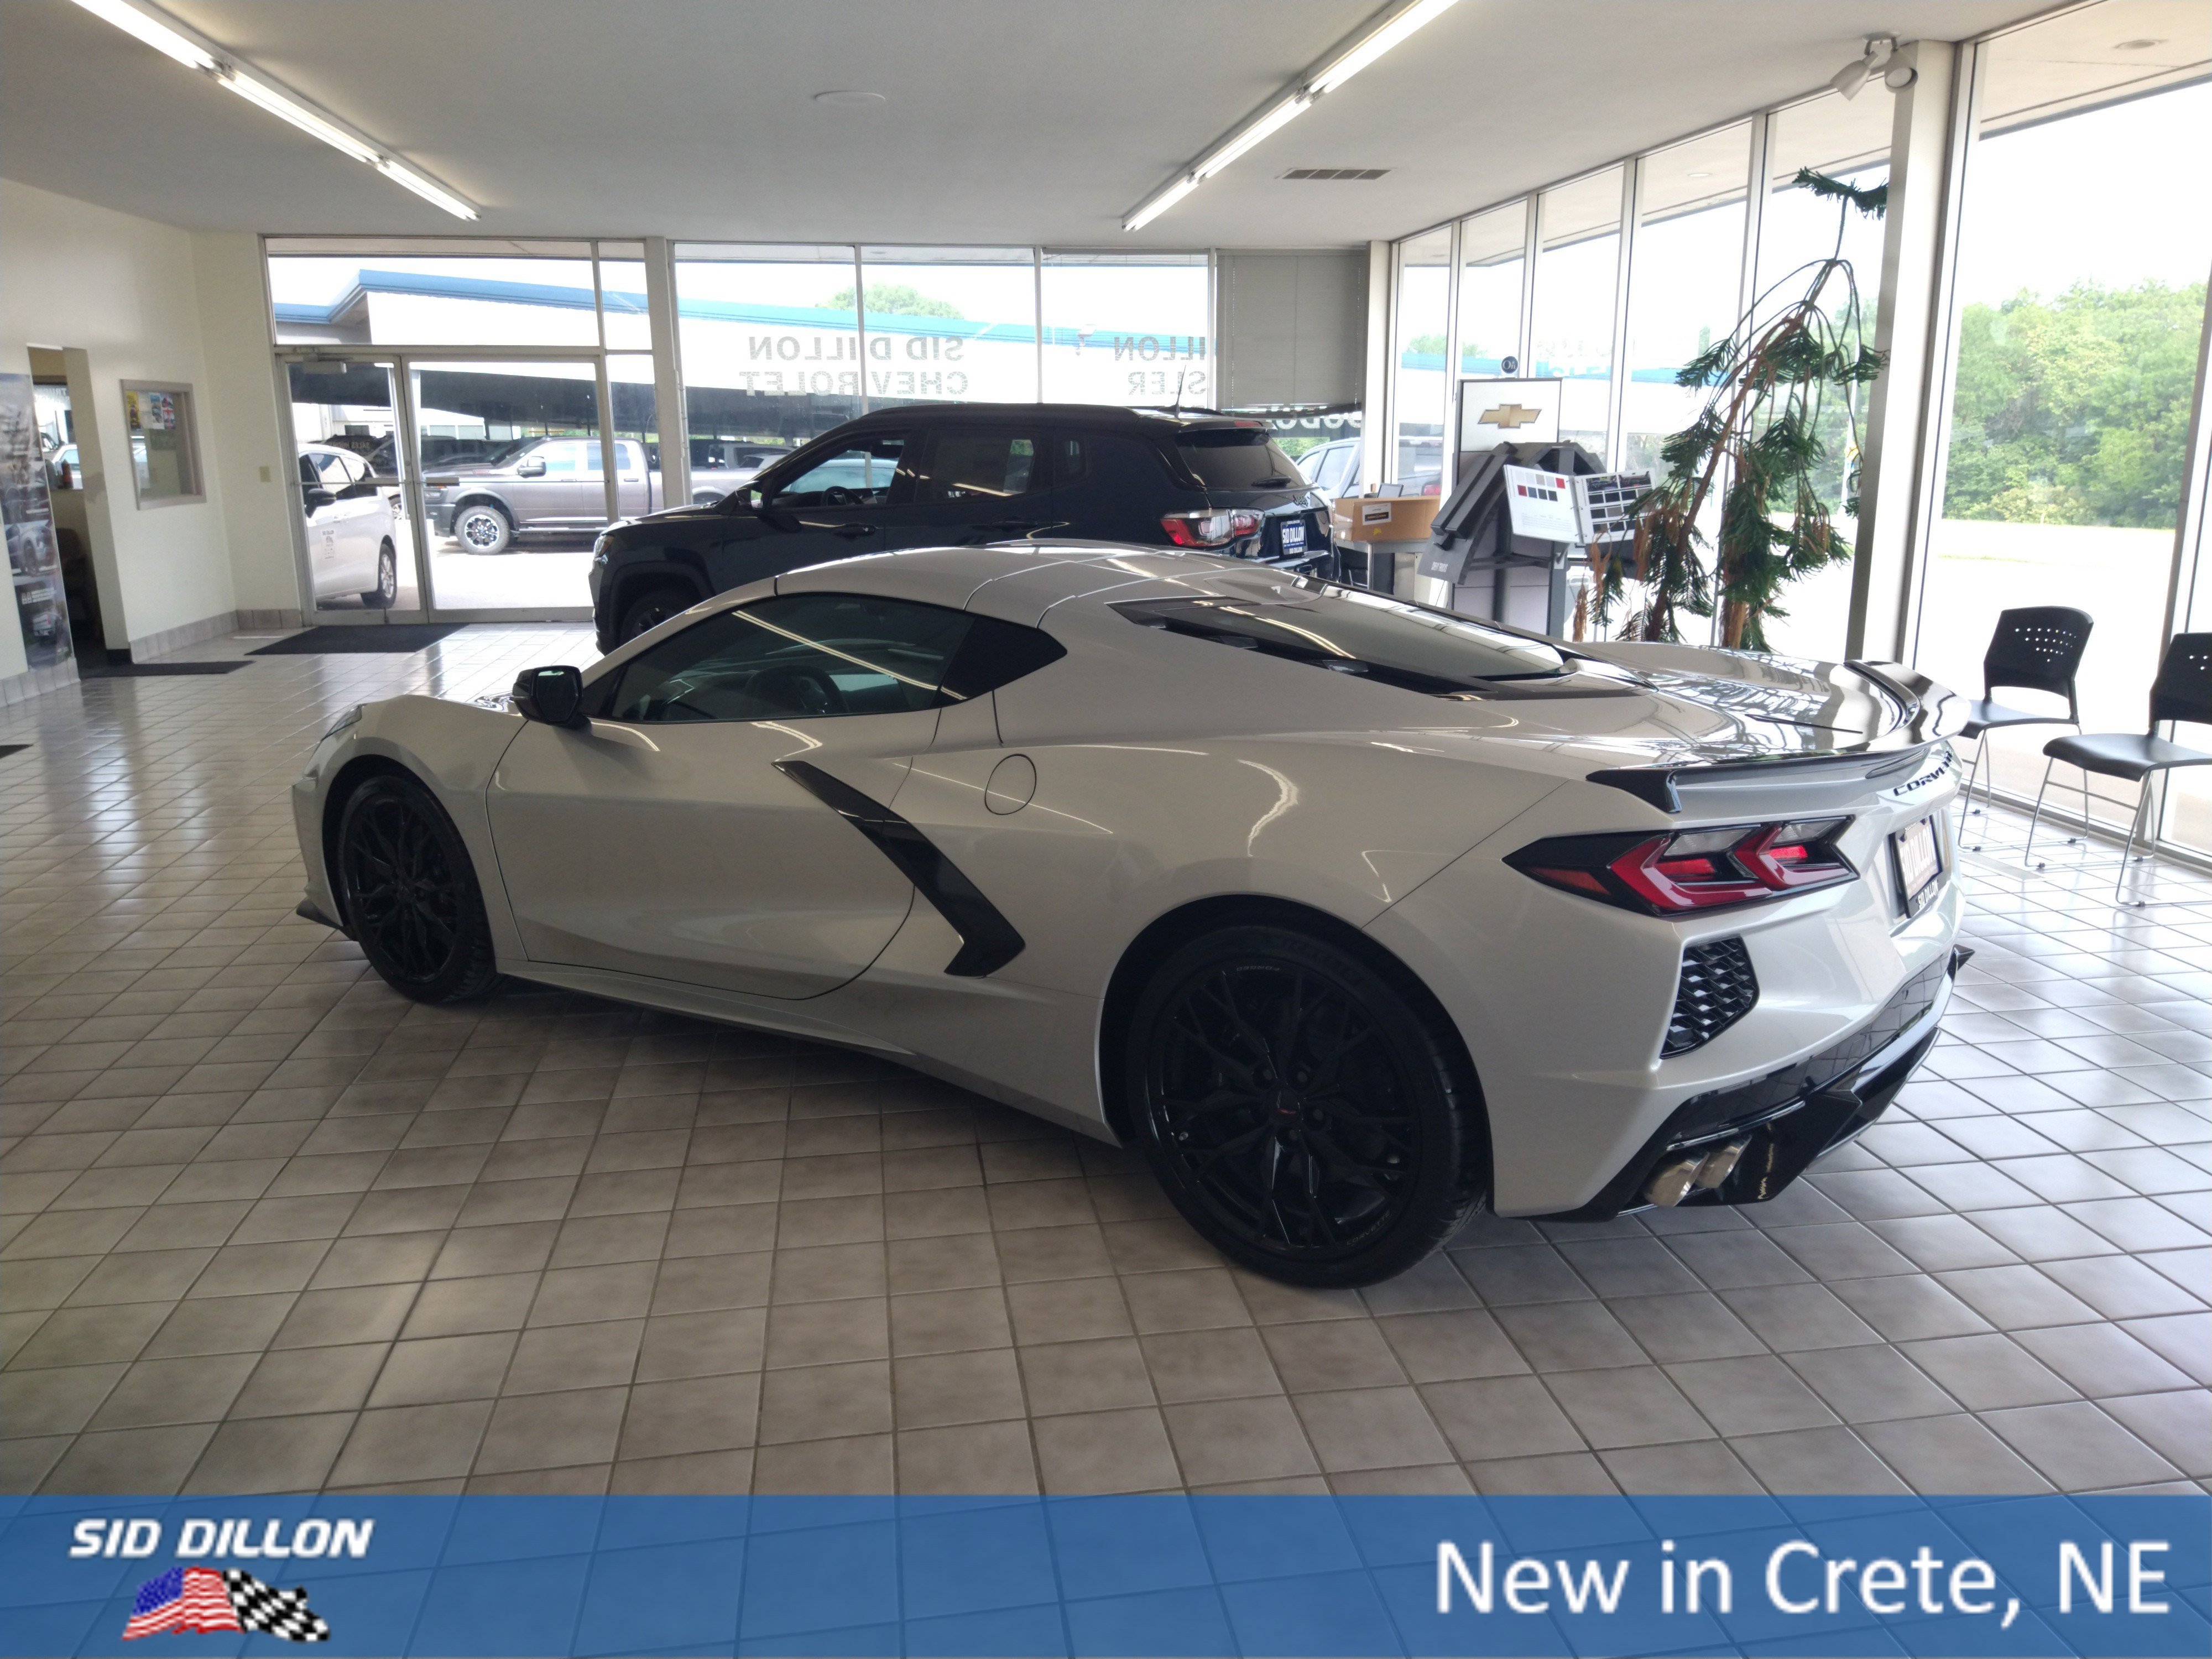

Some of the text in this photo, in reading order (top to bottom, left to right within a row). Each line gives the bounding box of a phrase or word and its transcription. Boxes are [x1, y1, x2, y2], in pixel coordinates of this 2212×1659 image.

[1290, 526, 1305, 543] DILLON
[1900, 843, 1914, 887] SID
[1910, 824, 1936, 878] DILLON
